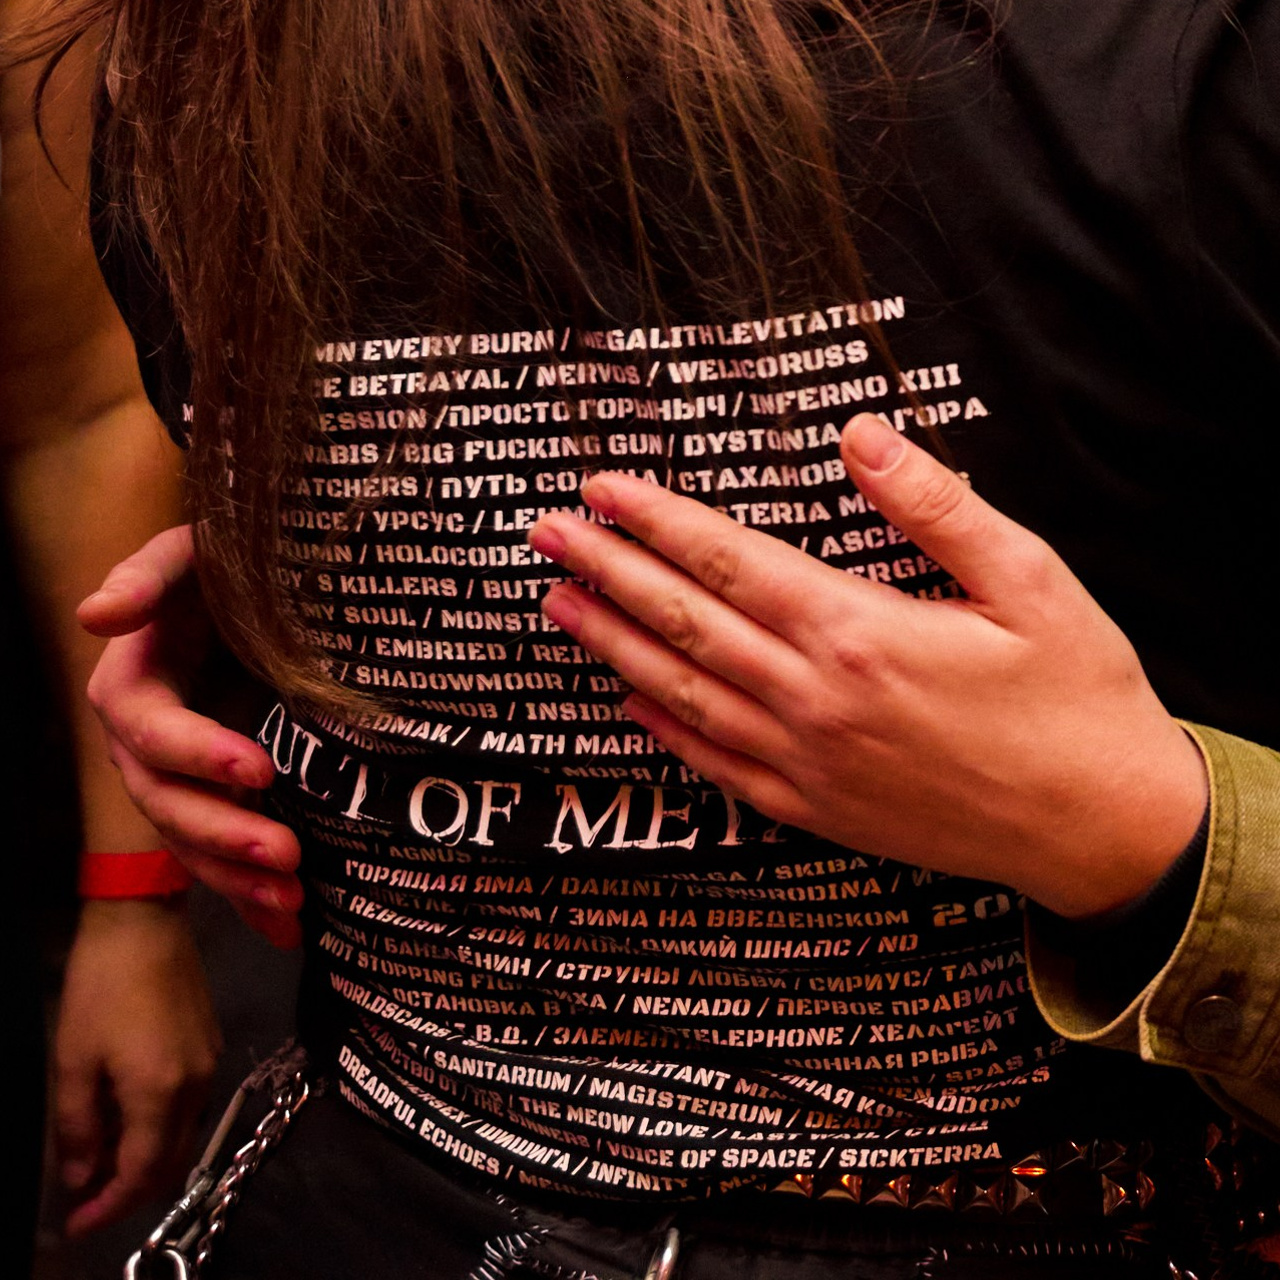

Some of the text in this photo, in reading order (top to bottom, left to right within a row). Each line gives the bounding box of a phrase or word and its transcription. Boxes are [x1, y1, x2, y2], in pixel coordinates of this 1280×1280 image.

[362, 333, 462, 361] EVERY
[471, 329, 554, 355] BURN
[350, 368, 509, 397] BETRAYAL
[536, 363, 640, 387] NERVOS
[668, 340, 868, 384] WELICORUSS
[320, 408, 427, 432] ESSION
[751, 375, 888, 414] INFERNO
[899, 363, 962, 394] XIII
[405, 441, 454, 465] BIG
[464, 435, 600, 463] FUCKING
[608, 433, 662, 457] GUN
[684, 422, 841, 458] DYSTONIA
[441, 474, 527, 499] ПУТЬ
[373, 511, 464, 534] УРСУС
[718, 501, 831, 526] TERIA
[341, 576, 458, 597] KILLERS
[345, 606, 416, 627] SOUL
[376, 637, 507, 661] EMBRIED
[356, 665, 564, 692] SHADOWMOOR
[357, 711, 453, 744] EDMAK
[480, 730, 565, 755] MATH
[409, 776, 522, 847] OF
[345, 858, 467, 893] ГОРЯЩАЯ
[474, 876, 533, 894] ЯМА
[561, 877, 662, 897] DAKINI
[775, 856, 868, 880] SKIBA
[349, 895, 448, 934] REBORN
[744, 938, 851, 959] ШНАПС
[568, 908, 648, 928] ЗИМА
[658, 909, 697, 928] НА
[707, 908, 909, 929] ВВЕДЕНСКОМ
[319, 931, 352, 962] NOT
[357, 951, 463, 989] STOPPING
[556, 963, 680, 985] СТРУНЫ
[688, 968, 787, 989] ЛЮБВИ
[809, 970, 921, 993] СИРИУС
[392, 987, 536, 1016] ОСТАНОВКА
[633, 996, 750, 1017] NENADO
[777, 998, 884, 1017] ПЕРВОЕ
[911, 1038, 998, 1067] РЫБА
[433, 1050, 572, 1093] SANITARIUM
[588, 1077, 783, 1127] MAGISTERIUM
[338, 1044, 417, 1131] DREADFUL
[418, 1117, 500, 1176] ECHOES
[518, 1096, 562, 1119] THE
[566, 1104, 634, 1135] MEOW
[638, 1117, 710, 1139] LOVE
[474, 1122, 571, 1172] ШИШИГА
[587, 1160, 689, 1192] INFINITY
[606, 1140, 674, 1168] VOICE
[680, 1149, 716, 1168] OF
[721, 1148, 816, 1169] SPACE
[838, 1142, 1002, 1169] SICKTERRA
